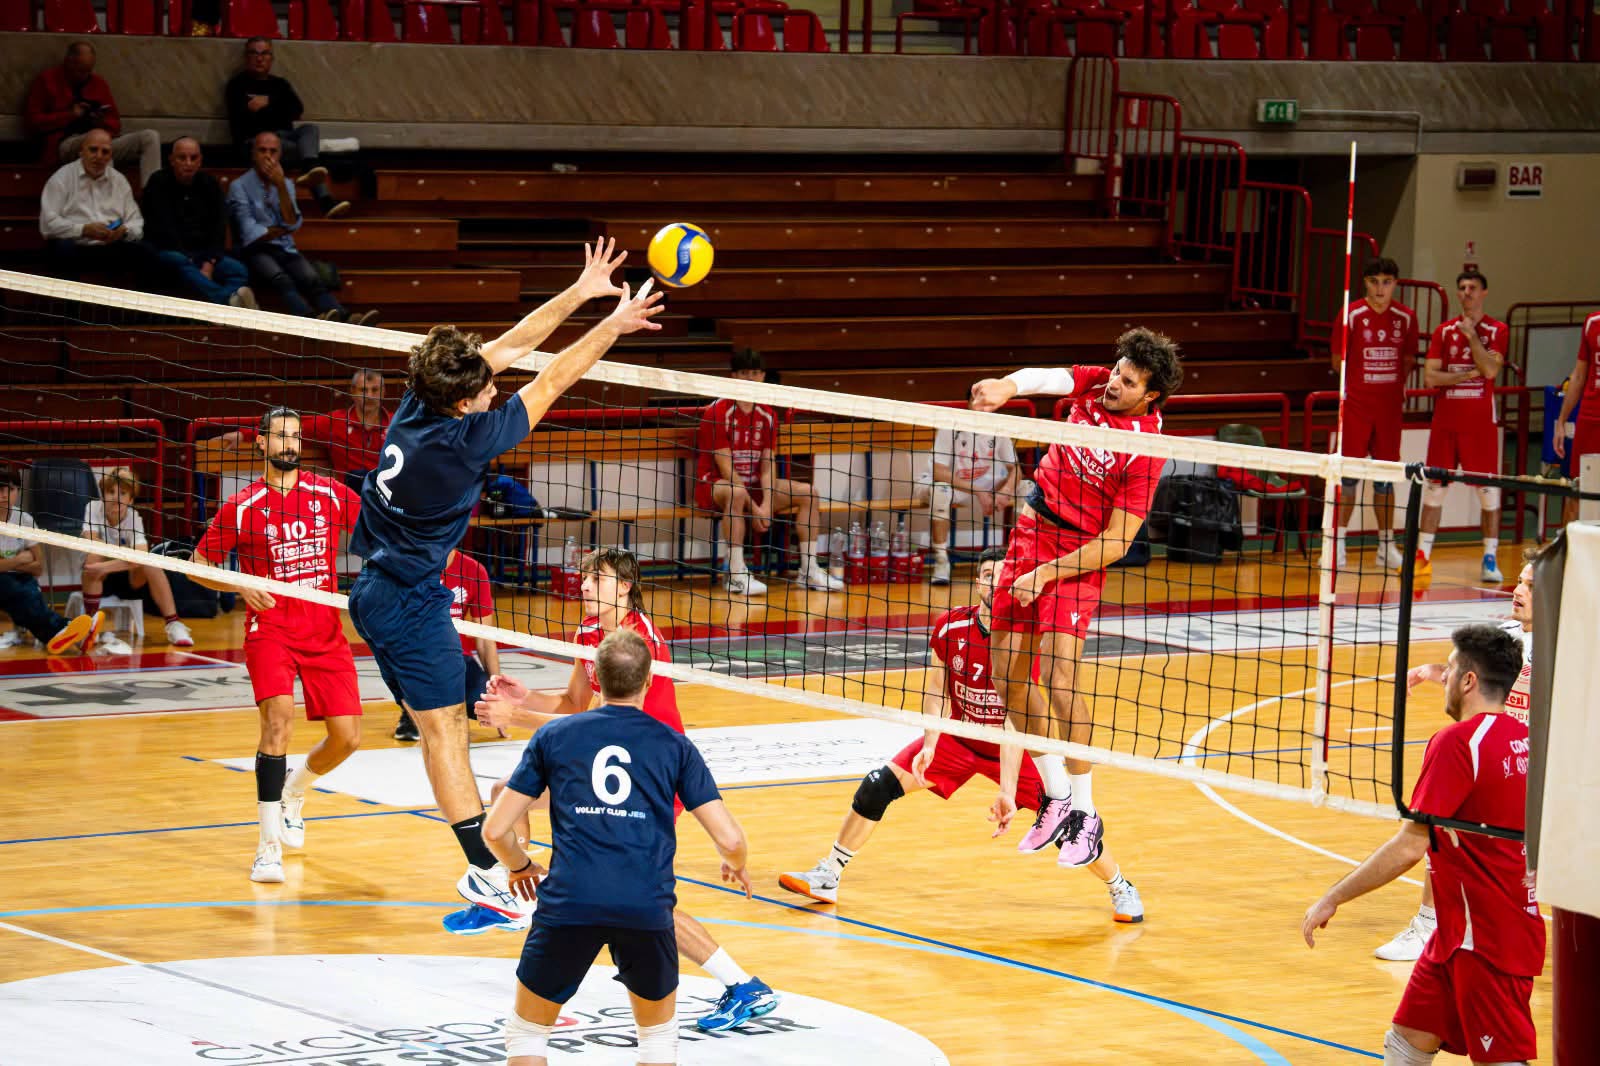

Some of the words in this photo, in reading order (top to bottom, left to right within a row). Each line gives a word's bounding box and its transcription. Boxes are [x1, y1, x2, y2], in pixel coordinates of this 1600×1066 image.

[1508, 166, 1543, 186] BAR
[1377, 329, 1387, 342] 9
[1461, 346, 1471, 360] 2
[376, 443, 404, 501] 2
[282, 521, 307, 541] 10
[972, 662, 984, 681] 7
[591, 744, 632, 806] 6
[574, 806, 606, 814] VOLLEY
[606, 807, 627, 817] CLUB
[627, 810, 646, 820] JESI
